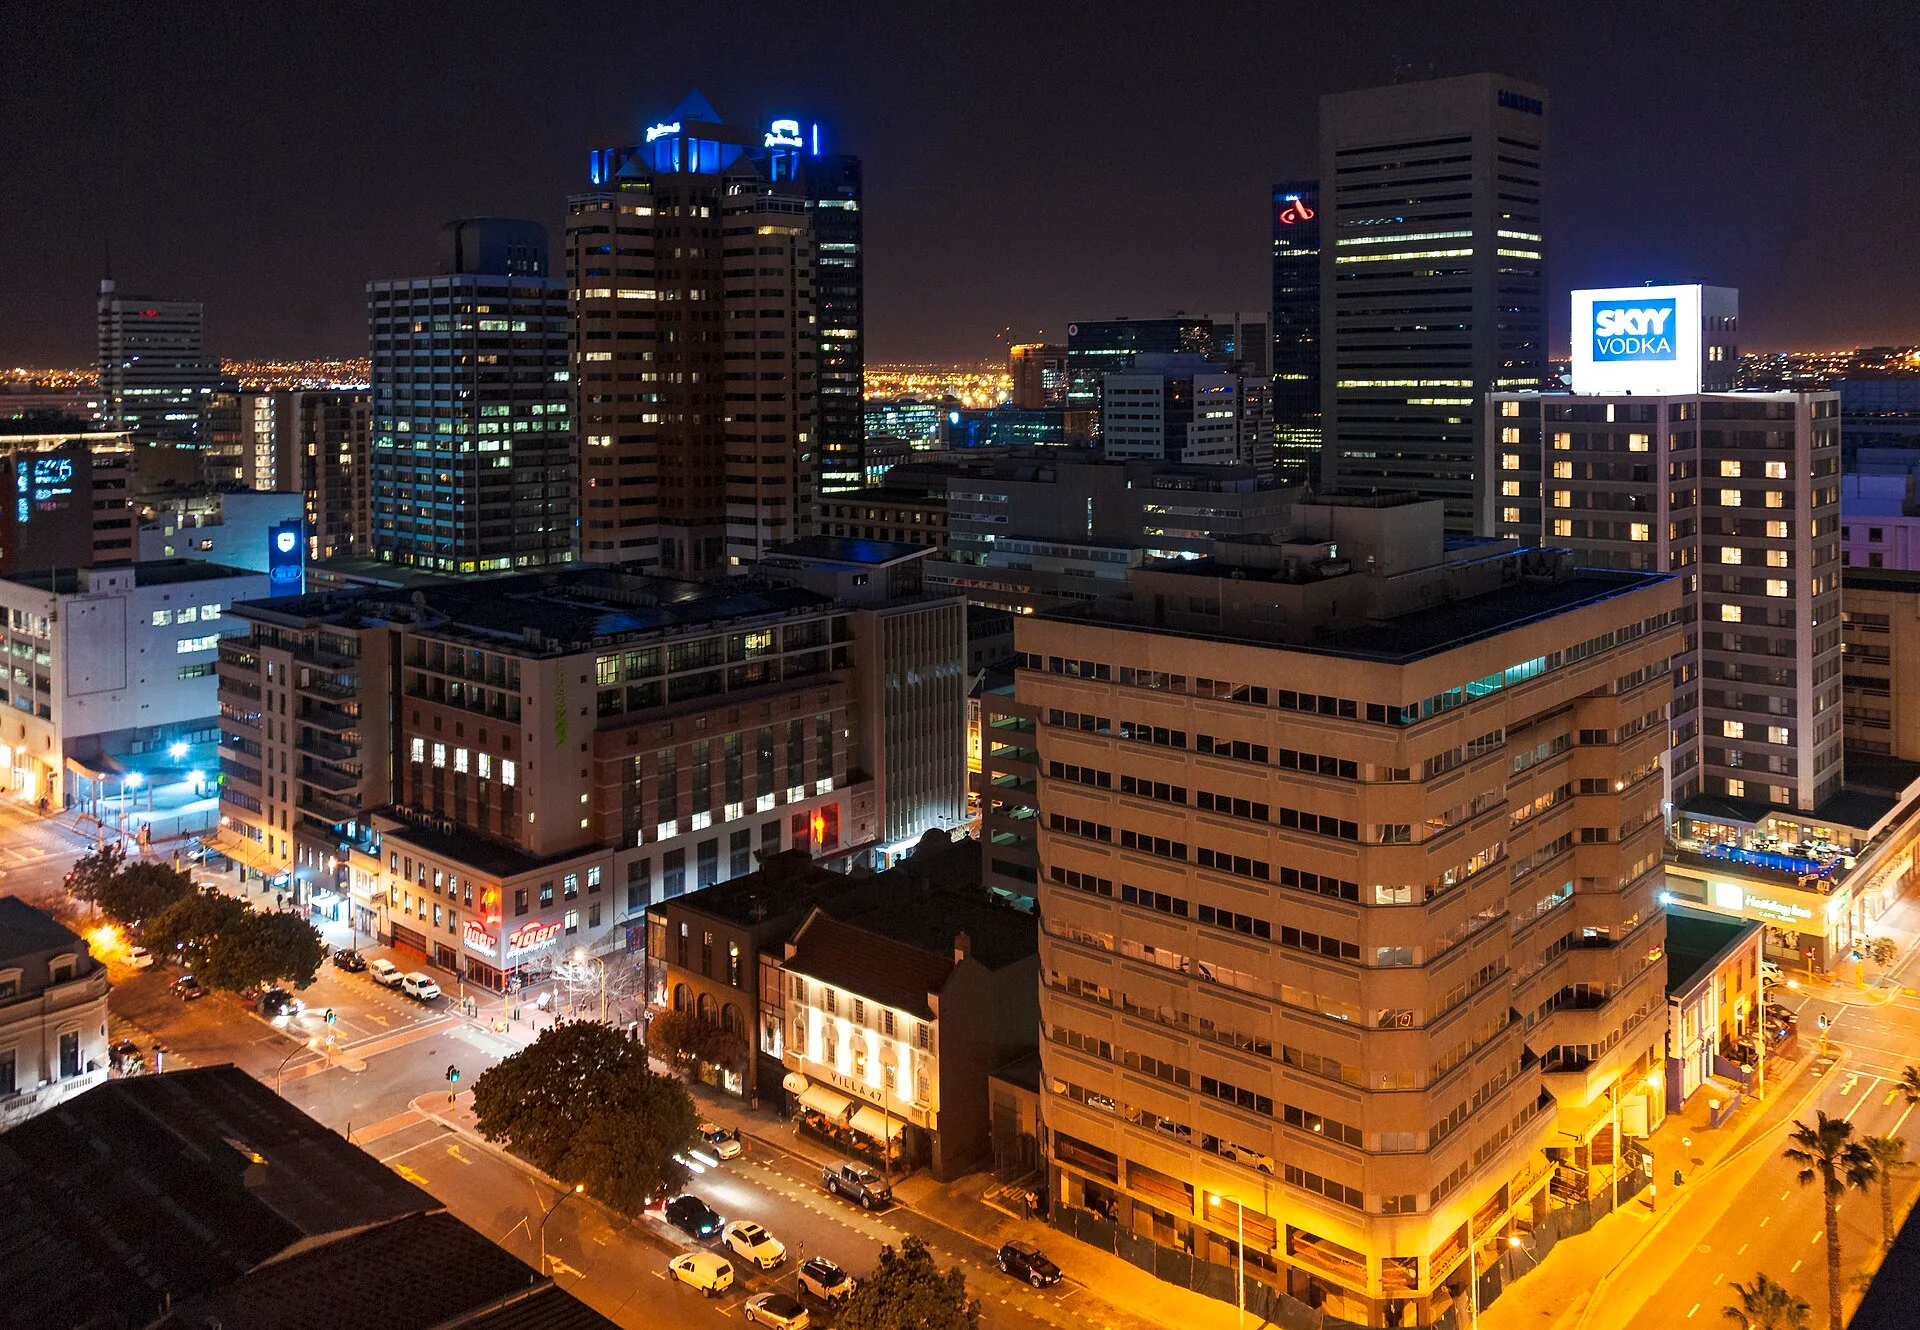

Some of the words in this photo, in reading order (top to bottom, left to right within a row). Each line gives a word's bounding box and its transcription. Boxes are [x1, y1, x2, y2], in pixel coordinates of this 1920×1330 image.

[1596, 308, 1673, 337] SKYY
[1596, 337, 1671, 355] VODKA
[463, 920, 497, 949] Tiger
[509, 920, 563, 950] Tiger
[831, 1072, 866, 1096] VILLA
[869, 1091, 882, 1102] 47
